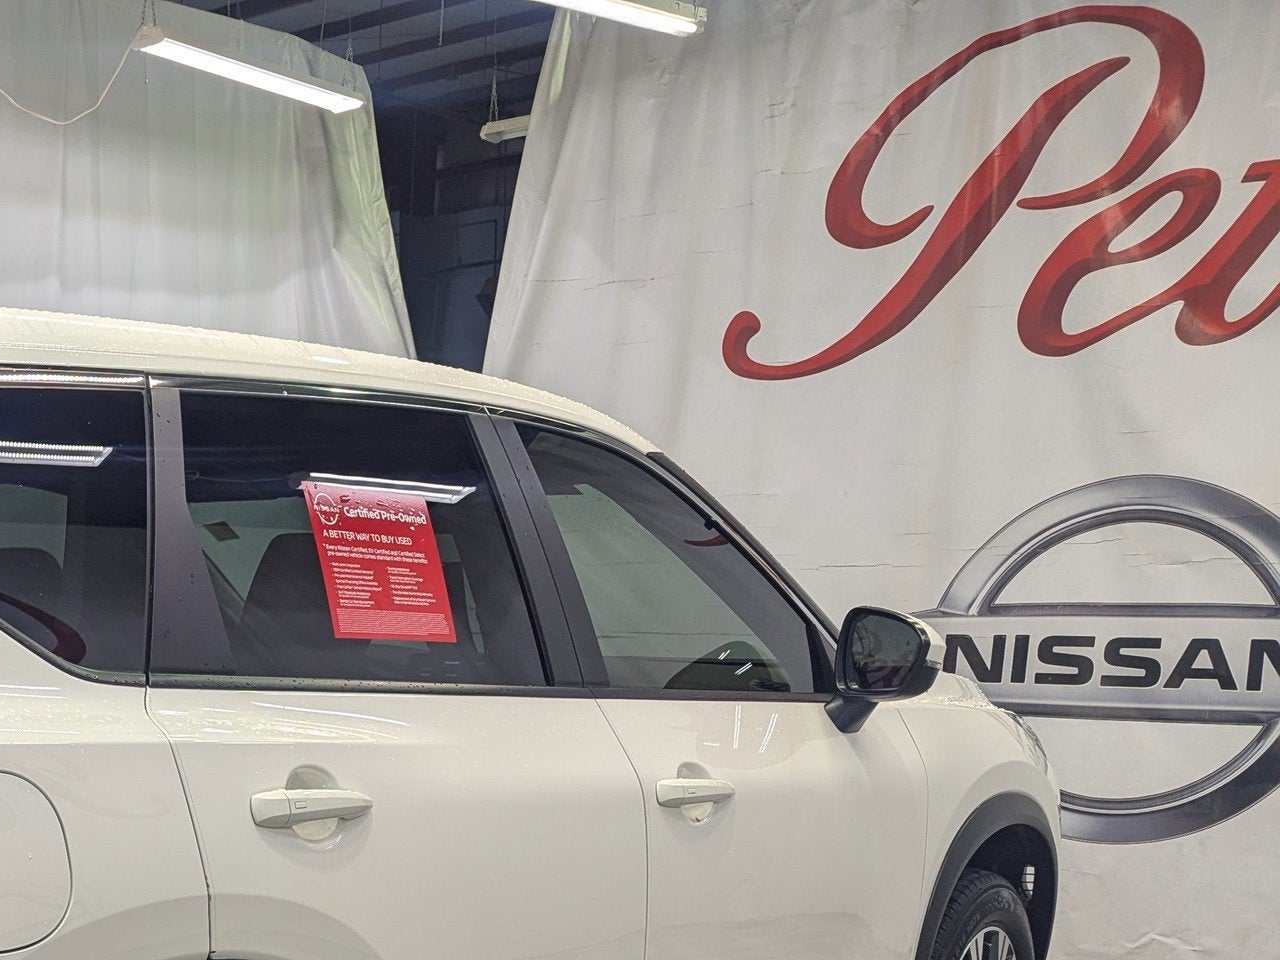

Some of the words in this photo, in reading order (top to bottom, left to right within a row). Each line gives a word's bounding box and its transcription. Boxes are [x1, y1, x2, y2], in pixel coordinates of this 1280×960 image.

[344, 505, 380, 519] Certified
[381, 509, 427, 525] Pre-Owned
[322, 529, 329, 538] A
[329, 530, 356, 540] BETTER
[356, 532, 370, 541] WAY
[370, 533, 381, 543] TO
[380, 535, 394, 544] BUY
[395, 536, 413, 546] USED
